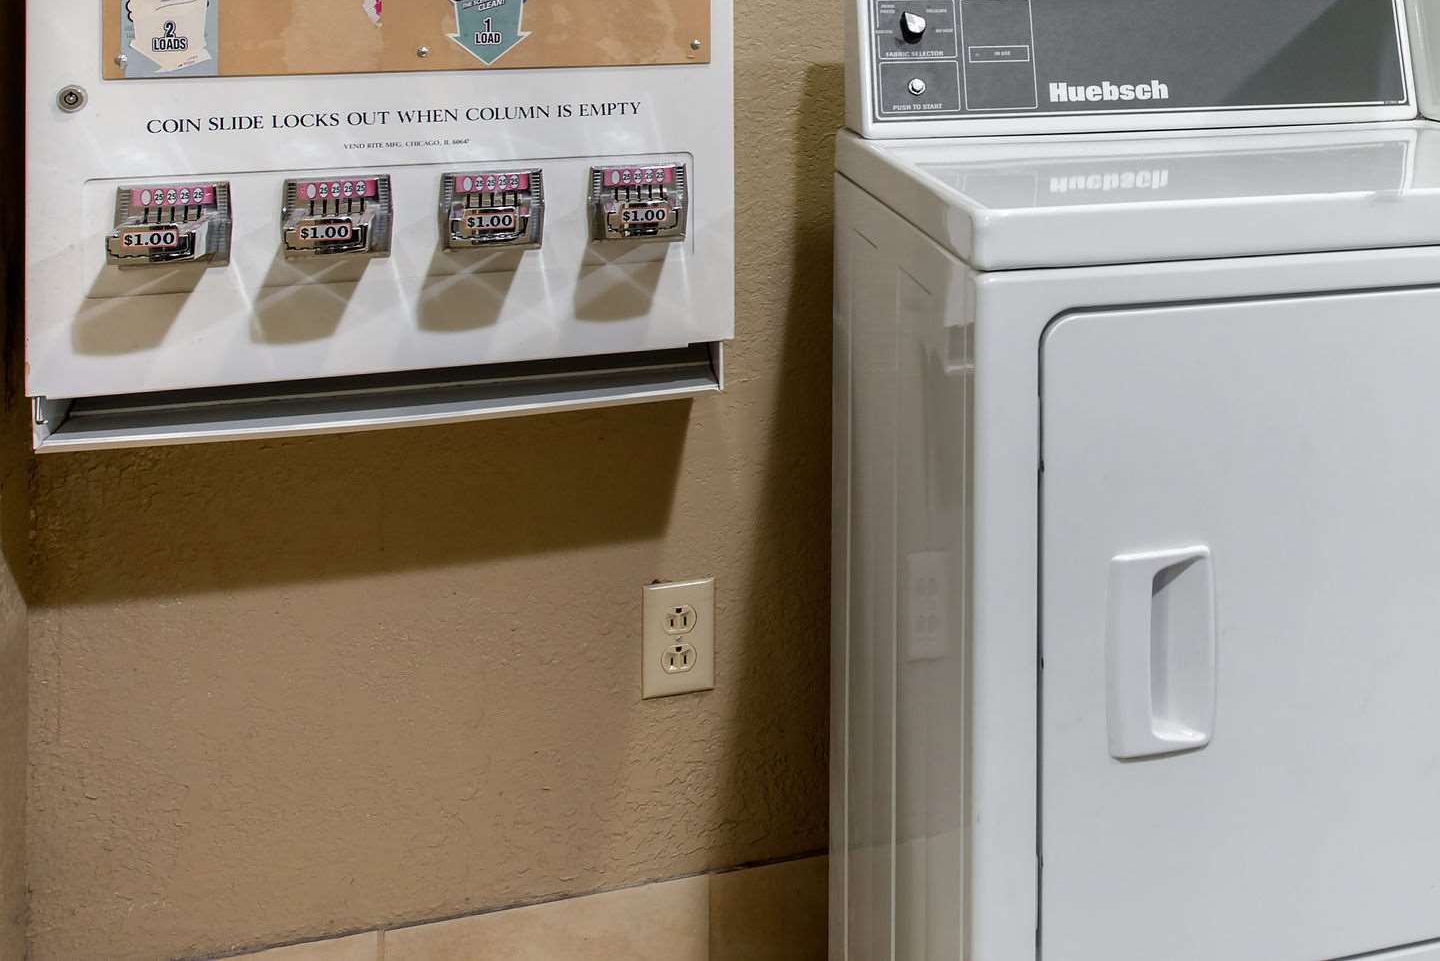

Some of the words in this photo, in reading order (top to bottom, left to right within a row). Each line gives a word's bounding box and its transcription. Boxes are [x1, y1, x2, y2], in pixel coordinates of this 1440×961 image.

[164, 21, 175, 38] 2
[153, 38, 187, 51] LOADS
[475, 33, 501, 44] LOAD
[1049, 80, 1169, 102] Huebsch
[147, 118, 201, 133] COIN
[208, 115, 264, 131] SLIDE
[272, 112, 339, 128] LOCKS
[347, 111, 390, 126] OUT
[397, 108, 458, 123] WHEN
[466, 105, 550, 121] COLUMN
[557, 104, 572, 118] IS
[580, 101, 641, 116] EMPTY
[467, 215, 512, 228] $1.00
[623, 209, 666, 222] $1.00
[124, 232, 175, 246] $1.00
[300, 226, 349, 240] $1.00
